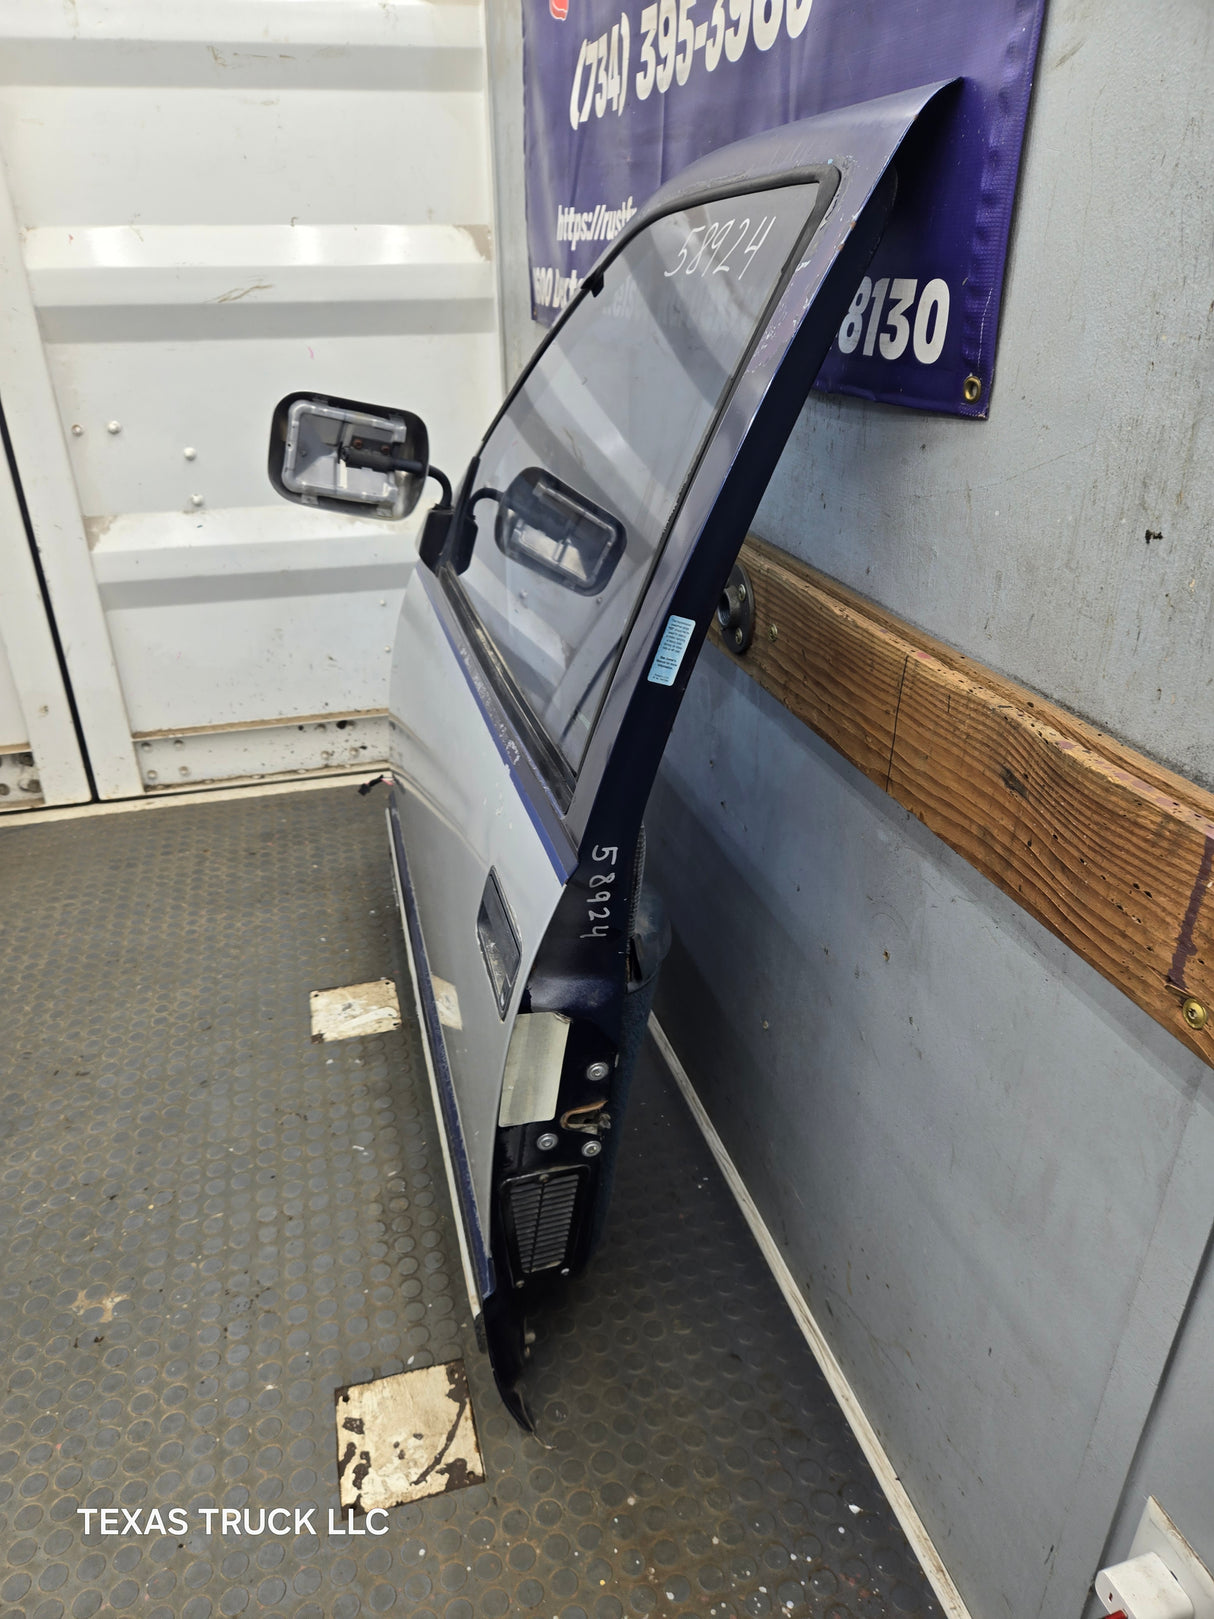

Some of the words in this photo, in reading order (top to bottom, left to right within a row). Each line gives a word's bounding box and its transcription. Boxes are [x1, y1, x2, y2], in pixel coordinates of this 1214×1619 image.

[569, 12, 630, 130] (734)
[664, 216, 776, 280] 58924
[579, 845, 618, 938] 58924
